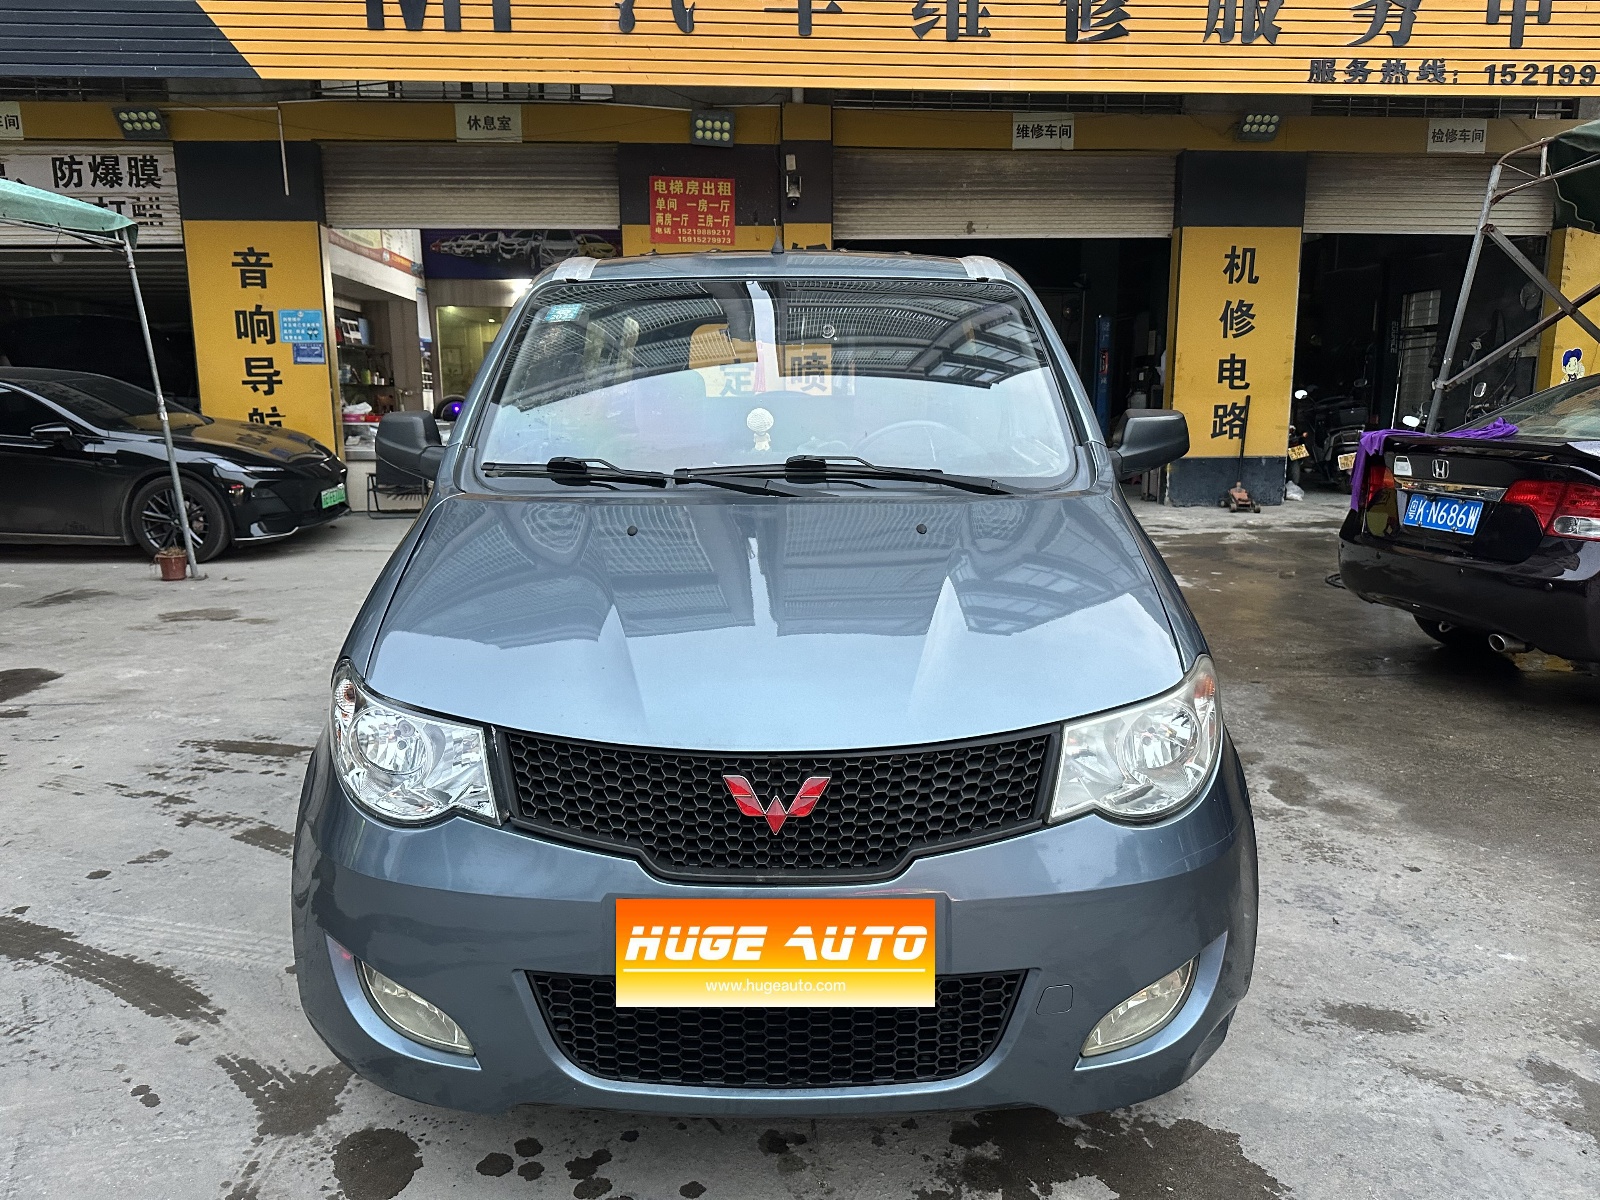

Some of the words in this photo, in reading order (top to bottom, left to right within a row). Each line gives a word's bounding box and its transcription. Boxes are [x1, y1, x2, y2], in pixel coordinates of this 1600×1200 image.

[1484, 63, 1597, 86] 152199
[0, 114, 20, 130] 间
[467, 115, 511, 131] 休息室
[1016, 123, 1072, 139] 维修车间
[1431, 128, 1484, 143] 检修车间
[654, 179, 732, 196] 电梯房出租
[655, 197, 677, 211] 单间
[686, 199, 730, 212] 一房一厅
[655, 212, 689, 227] 两房一厅
[697, 214, 730, 228] 三房一厅
[1211, 245, 1260, 440] 机修电路
